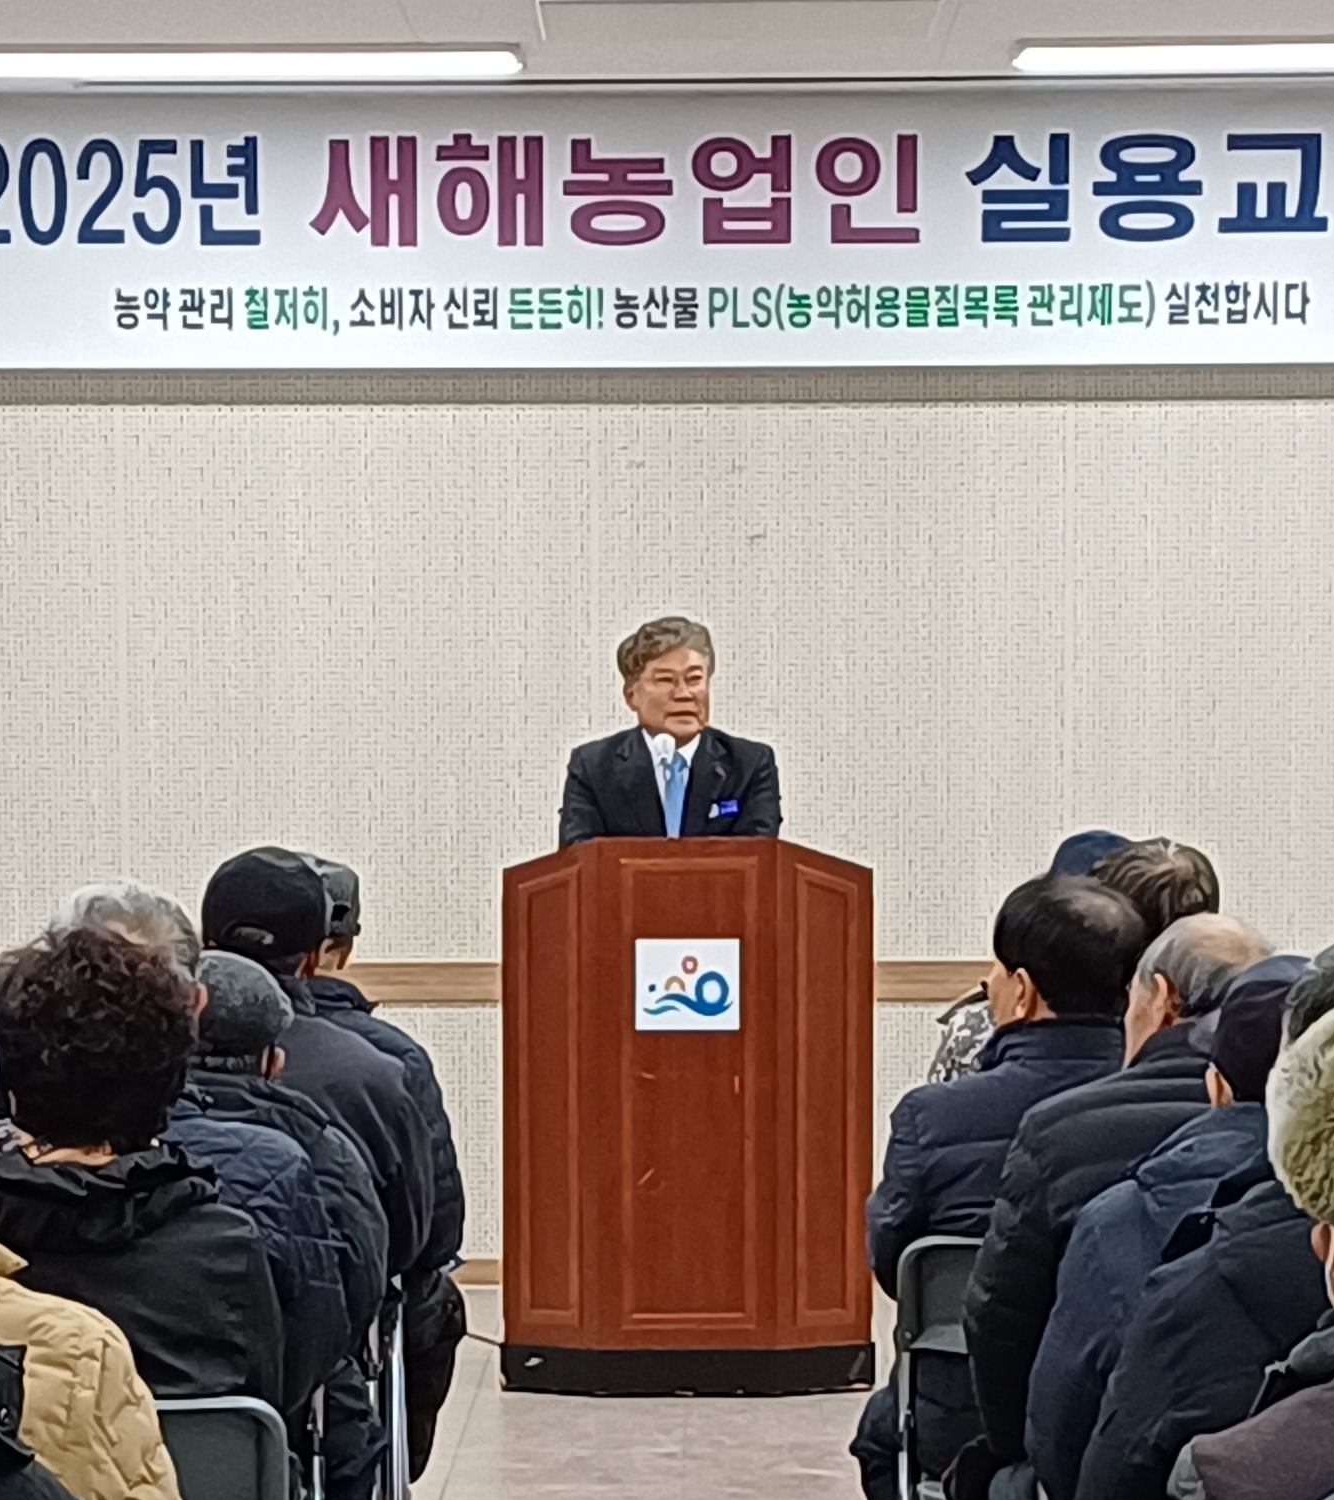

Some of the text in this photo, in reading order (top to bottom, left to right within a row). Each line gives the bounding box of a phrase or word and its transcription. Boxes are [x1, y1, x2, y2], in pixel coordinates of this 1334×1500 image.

[309, 133, 922, 247] 새해농업인
[113, 287, 171, 331] 농약
[178, 286, 234, 331] 관리
[244, 285, 340, 336] 철저히,
[348, 287, 435, 331] 소비자
[443, 286, 499, 330] 신뢰
[507, 284, 604, 330] 든든히!
[613, 285, 700, 330] 농산물
[1026, 279, 1156, 329] 관리제도)
[1164, 280, 1311, 326] 실천합시다
